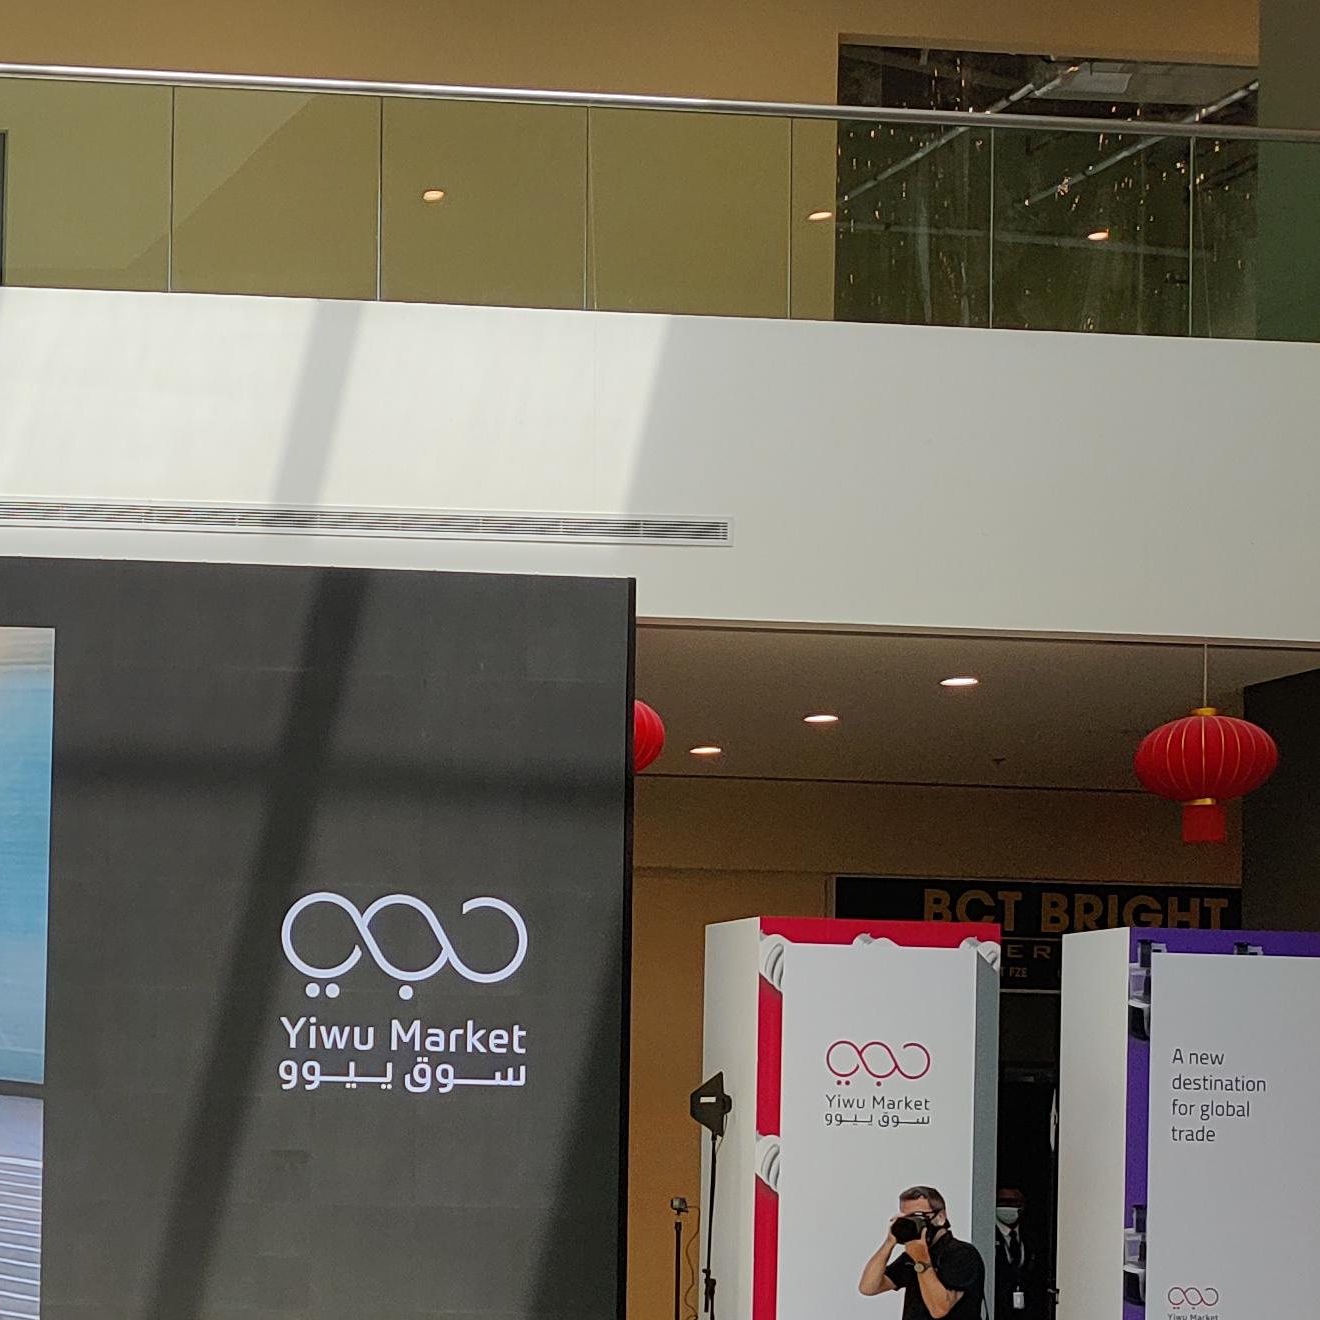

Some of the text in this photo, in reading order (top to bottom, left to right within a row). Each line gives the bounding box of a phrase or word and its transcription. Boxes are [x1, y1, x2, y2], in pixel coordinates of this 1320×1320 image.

[924, 888, 1228, 933] BCT BRIGHT
[279, 1016, 527, 1054] Yiwu Market
[1172, 1048, 1224, 1065] A new
[404, 1056, 526, 1093] سوق
[1172, 1073, 1266, 1092] destination
[825, 1094, 930, 1110] Yiwu Market
[1172, 1098, 1250, 1121] for global
[878, 1112, 930, 1127] سوق
[1171, 1125, 1216, 1142] trade
[1167, 1313, 1188, 1320] Yiwu
